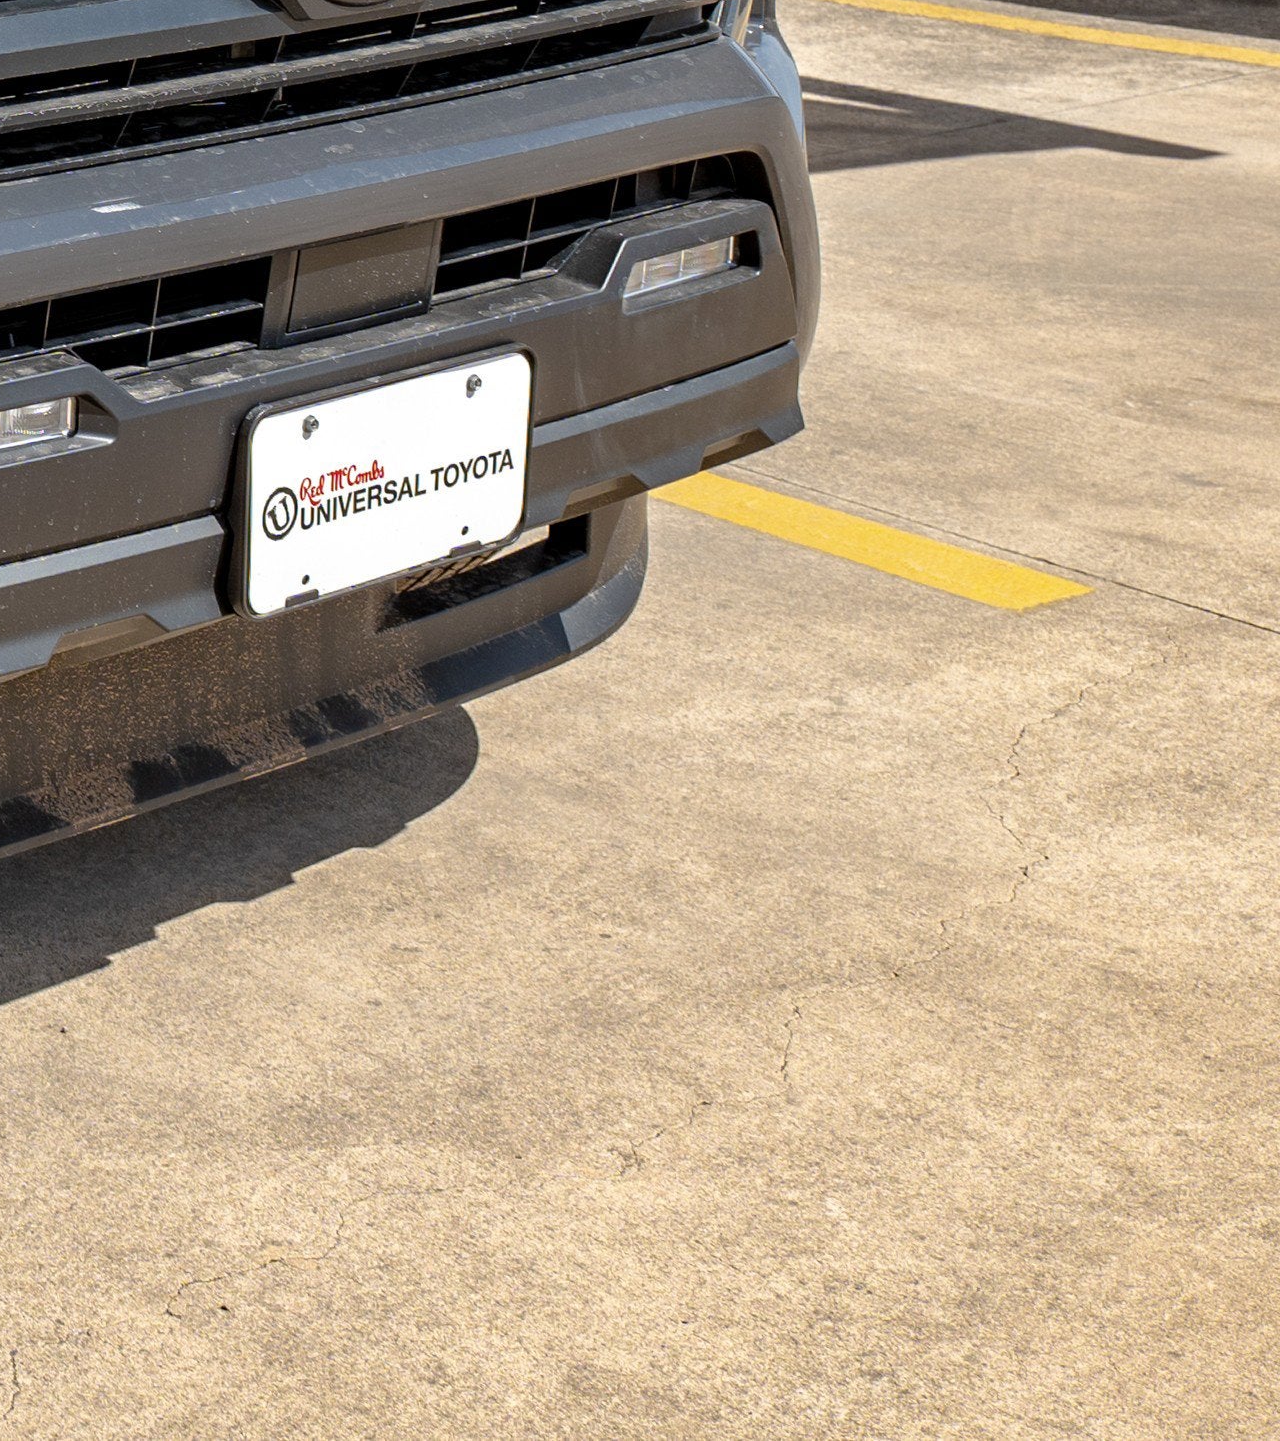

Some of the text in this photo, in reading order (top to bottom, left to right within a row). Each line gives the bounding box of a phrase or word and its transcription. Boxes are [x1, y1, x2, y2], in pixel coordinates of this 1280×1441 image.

[300, 460, 385, 506] Red McCombs
[300, 473, 427, 530] UNIVERSAL
[431, 448, 515, 491] TOYOTA
